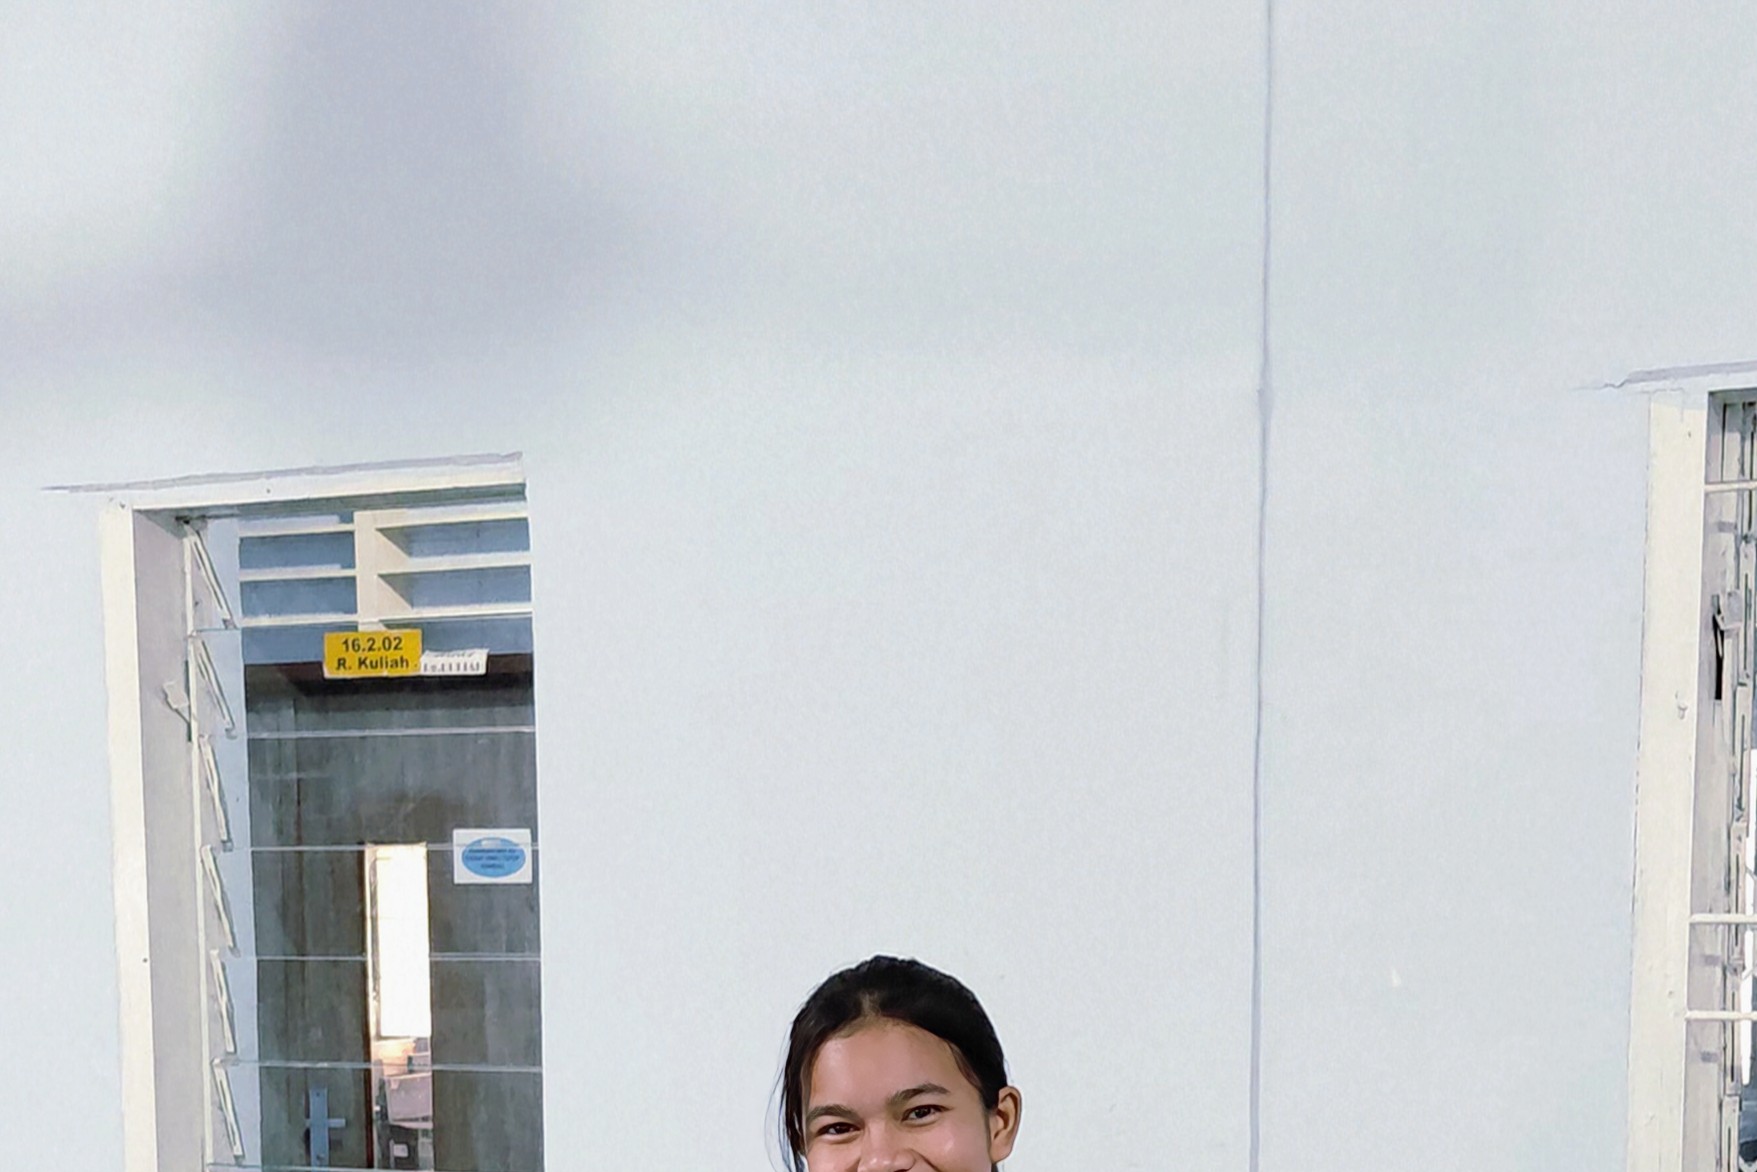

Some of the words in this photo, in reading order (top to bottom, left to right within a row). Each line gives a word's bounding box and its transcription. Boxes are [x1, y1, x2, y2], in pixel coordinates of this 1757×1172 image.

[342, 636, 403, 652] 16.2.02
[335, 656, 352, 671] R.
[358, 656, 409, 670] Kuliah
